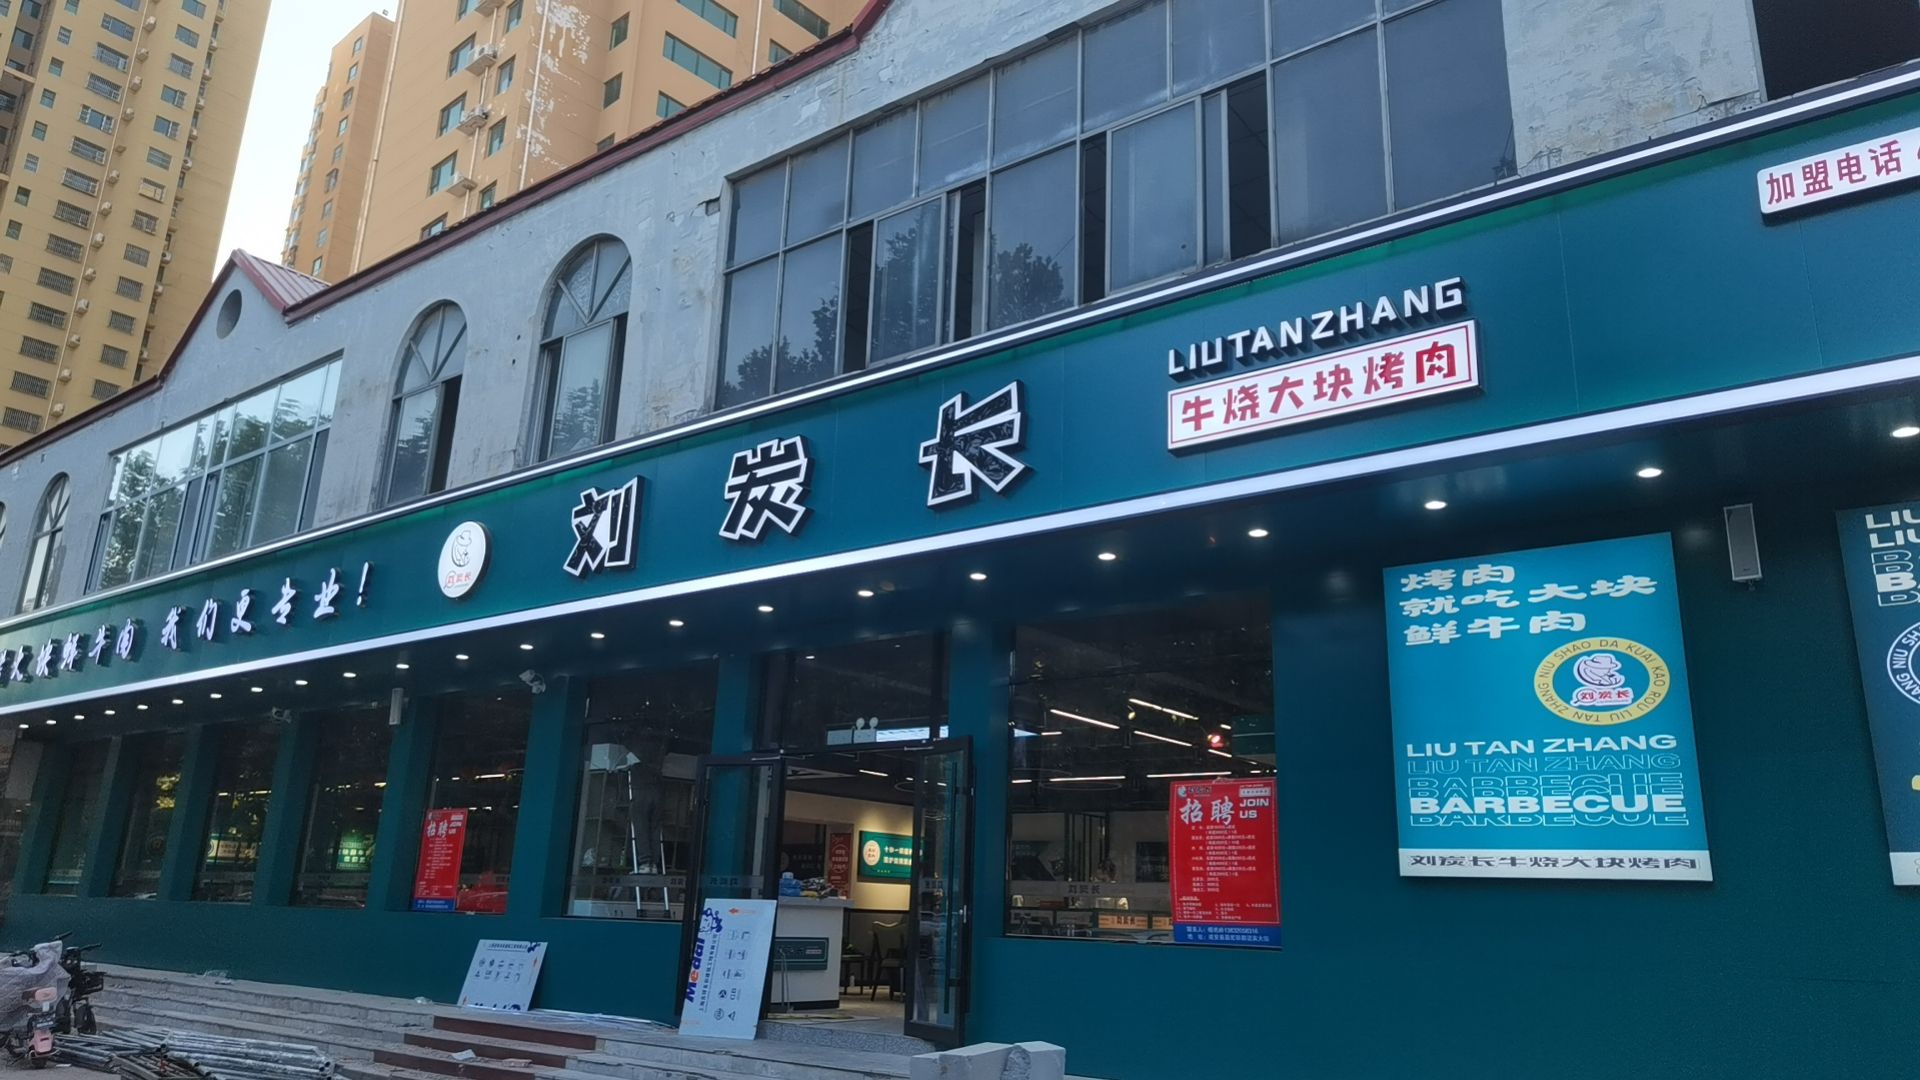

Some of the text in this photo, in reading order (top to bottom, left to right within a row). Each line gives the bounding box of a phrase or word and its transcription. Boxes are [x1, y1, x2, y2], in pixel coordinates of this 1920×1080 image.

[1766, 139, 1902, 205] 加盟电话
[1168, 276, 1464, 376] LIUTANZHANG
[1181, 340, 1457, 432] 牛烧大块烤肉
[563, 380, 1029, 577] 刘炭长
[1401, 564, 1516, 592] 烤肉
[1400, 575, 1658, 617] 就吃大块
[1403, 610, 1587, 645] 鲜牛肉
[1537, 639, 1666, 722] NIU SHAO DA KUAI KAO ROU LIU TAN ZHANG
[1407, 734, 1677, 758] LIU TAN ZHANG
[1408, 753, 1681, 775] LIU TAN ZHANG
[1179, 796, 1235, 825] 招聘
[1239, 798, 1270, 808] JOIN
[1239, 809, 1257, 819] US
[1409, 794, 1687, 815] BARBECUE
[1410, 855, 1696, 870] 刘炭长牛烧大块烤肉
[685, 937, 706, 1003] Medal
